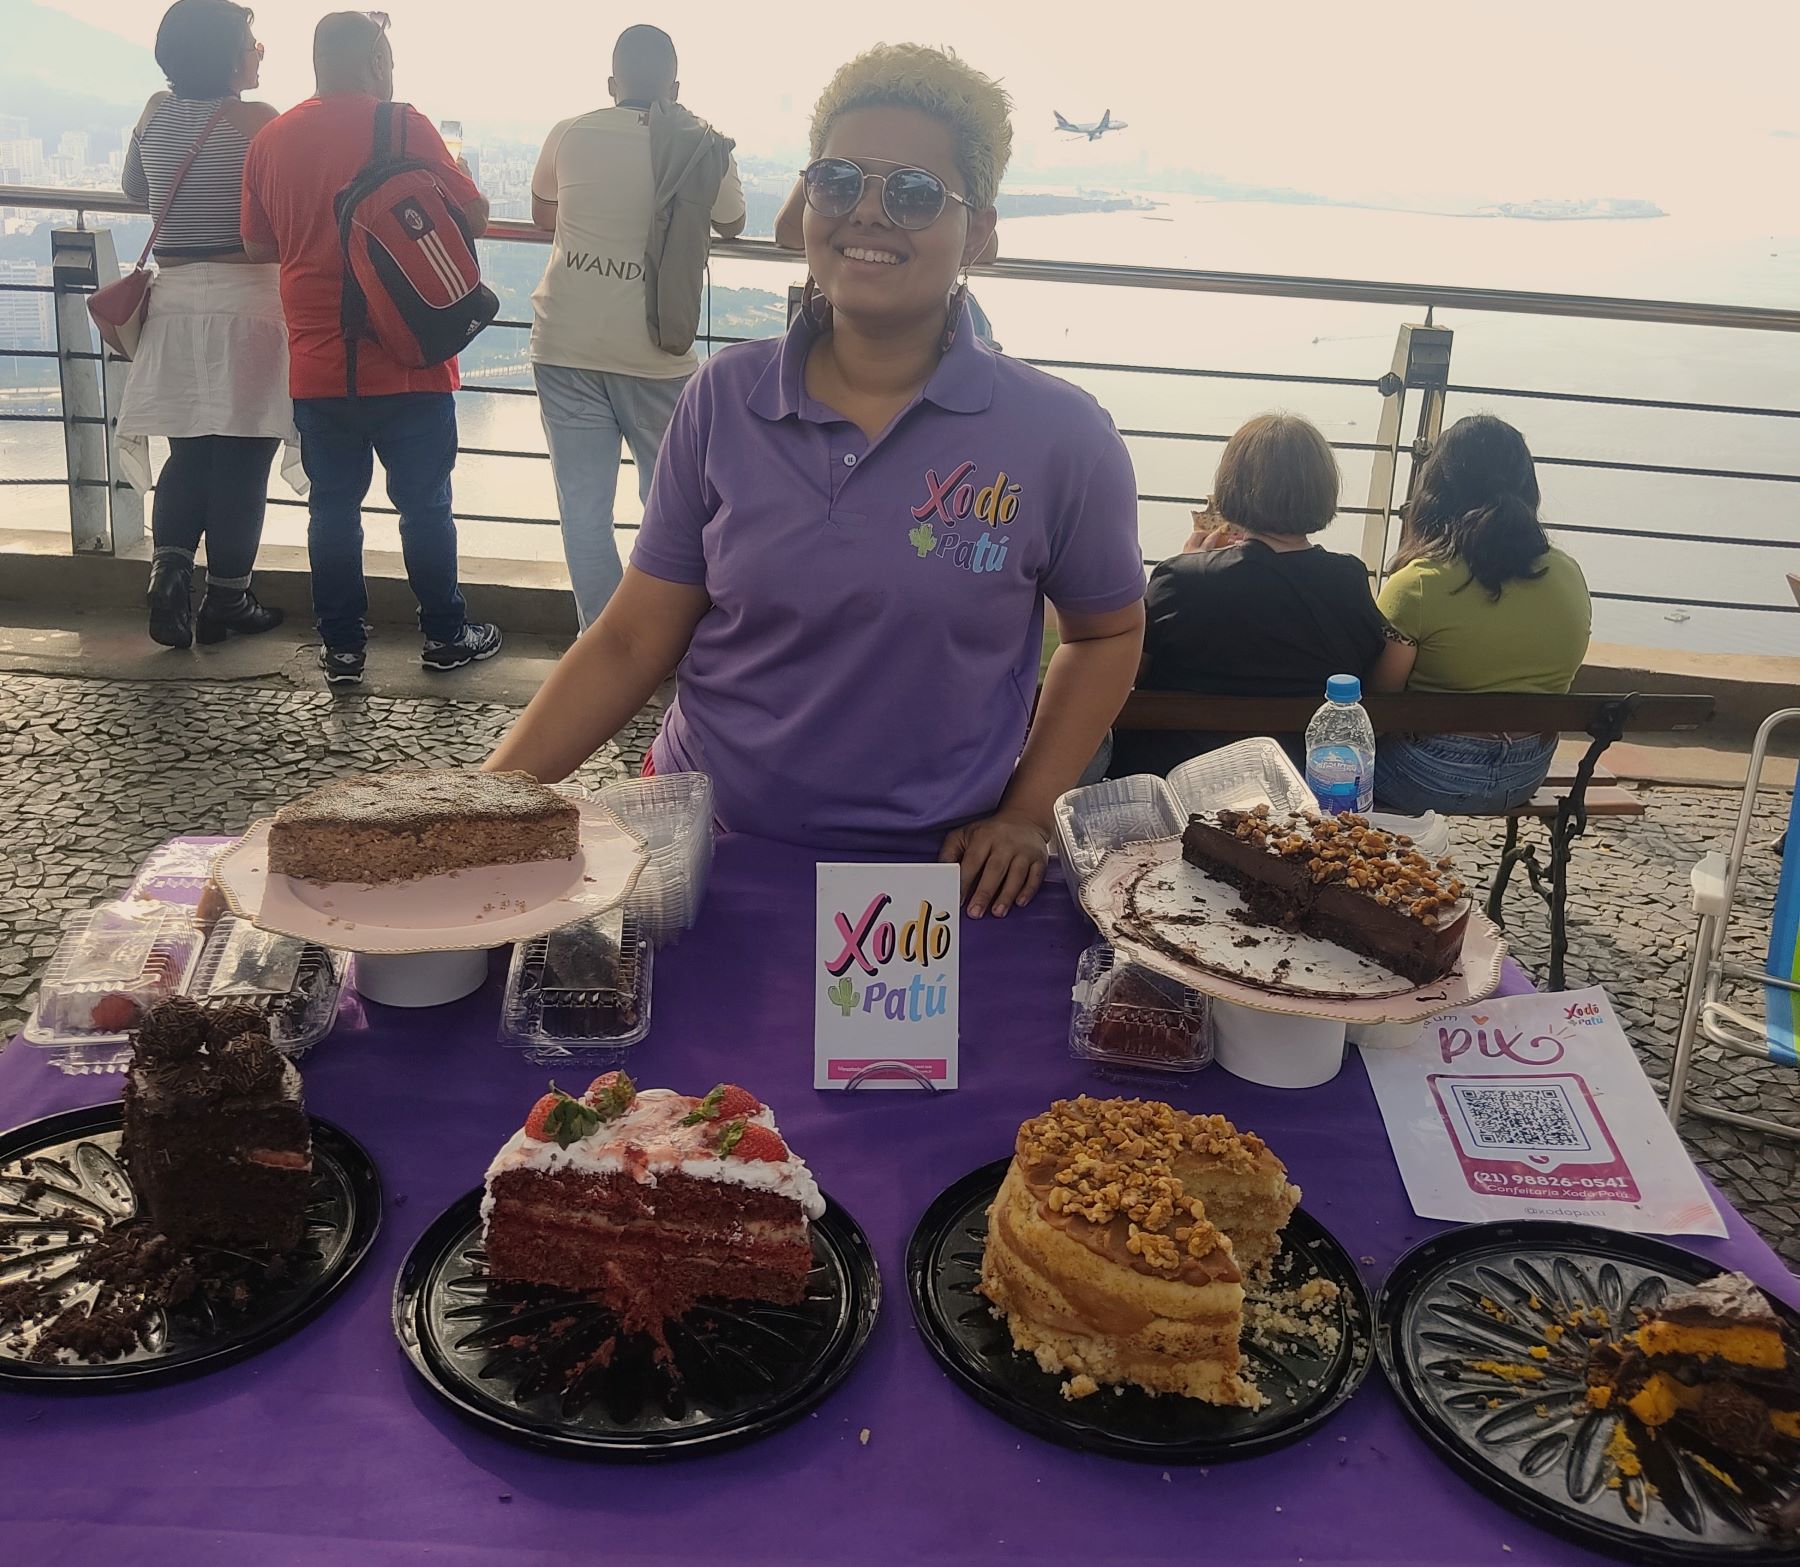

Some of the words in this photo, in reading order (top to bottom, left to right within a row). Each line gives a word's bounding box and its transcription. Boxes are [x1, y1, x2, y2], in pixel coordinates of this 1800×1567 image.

[566, 251, 645, 282] WAND
[911, 461, 1023, 529] Xodó
[936, 532, 1010, 573] Patú
[824, 893, 951, 977] Xodó
[862, 973, 947, 1022] Patú
[1438, 1027, 1565, 1066] pix
[1473, 1171, 1507, 1185] (21)
[1511, 1175, 1628, 1188] 98826-0541
[1487, 1184, 1559, 1198] Confeitaria
